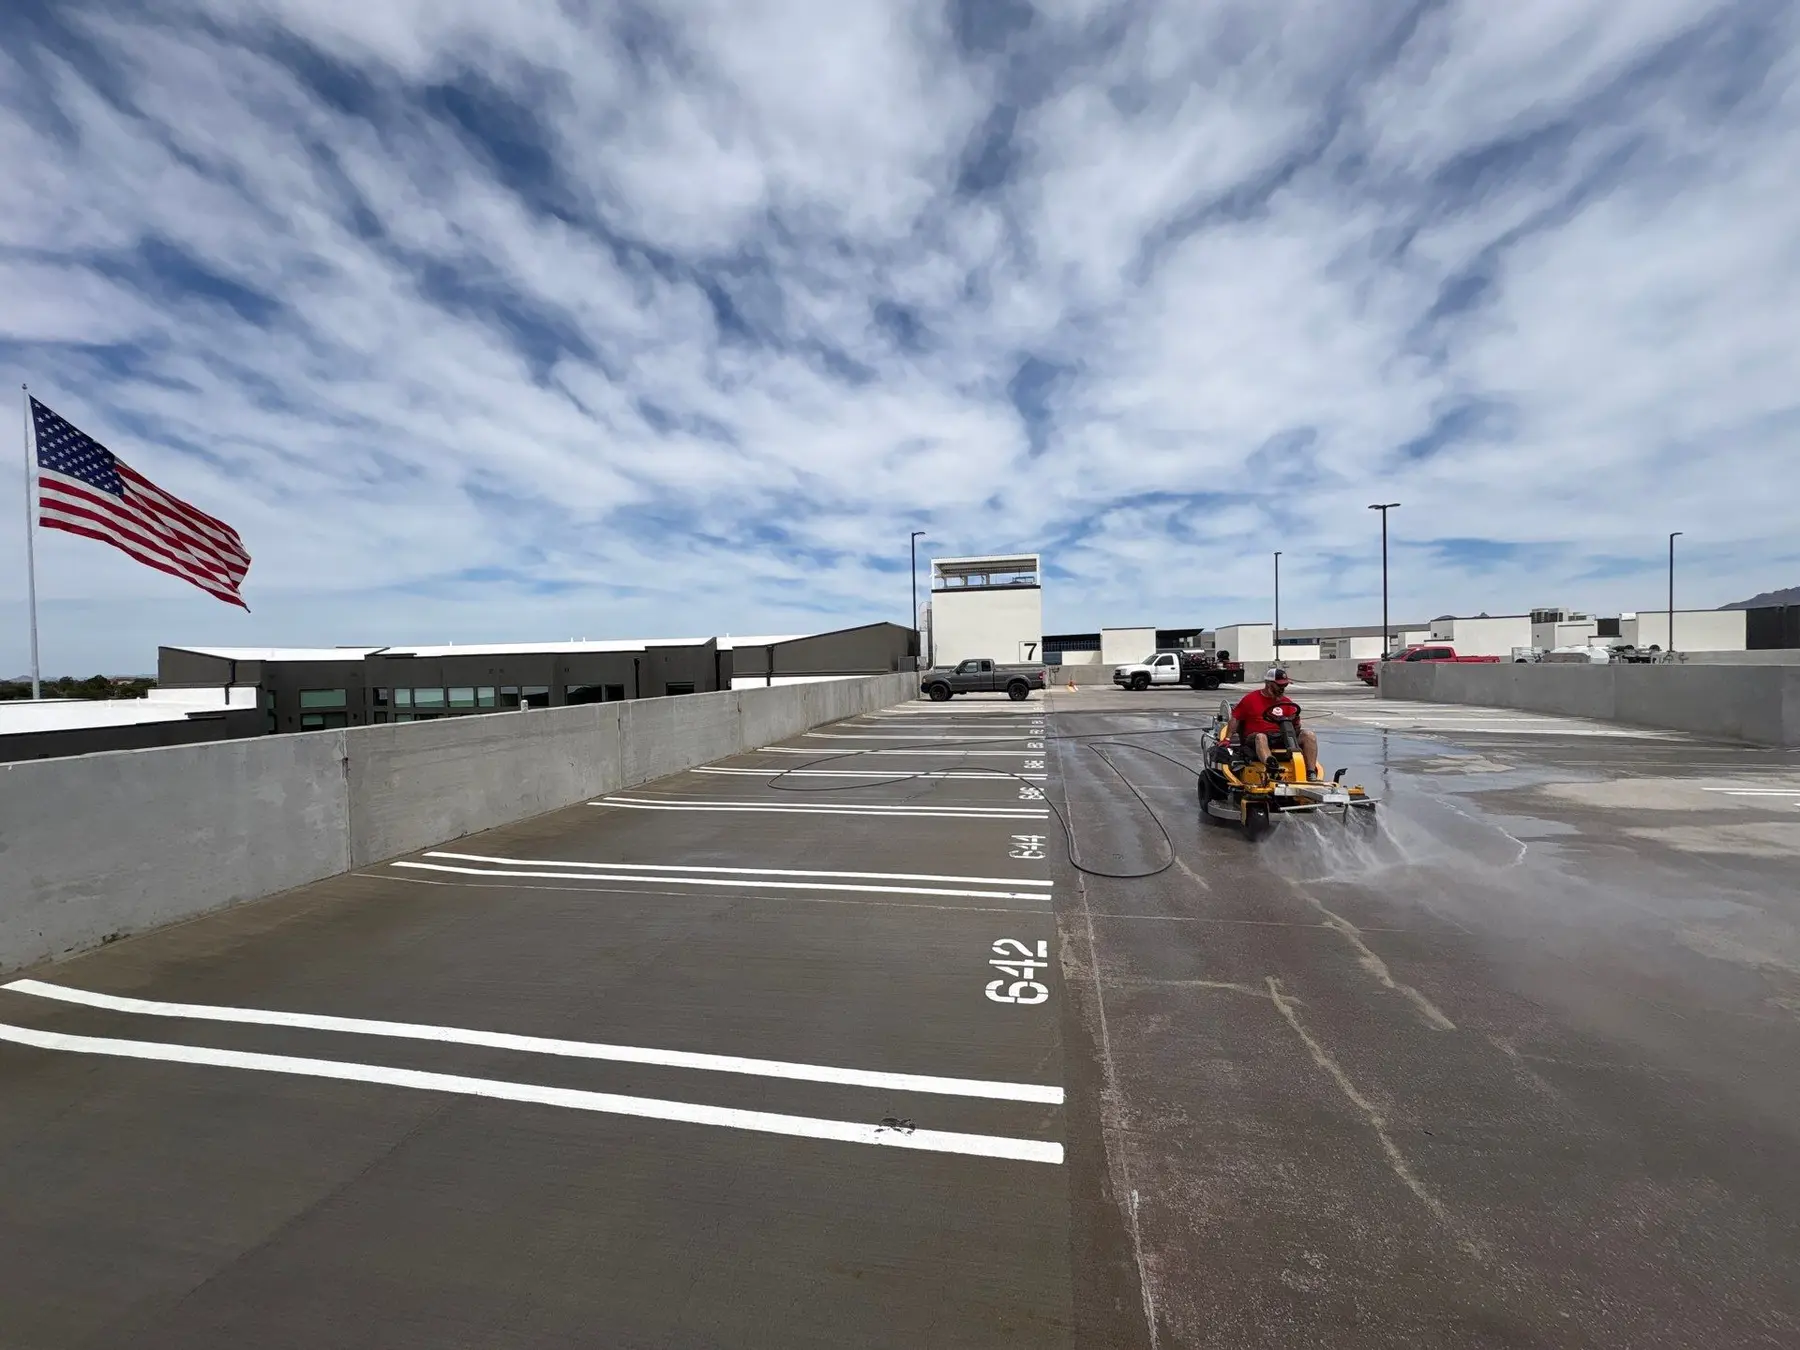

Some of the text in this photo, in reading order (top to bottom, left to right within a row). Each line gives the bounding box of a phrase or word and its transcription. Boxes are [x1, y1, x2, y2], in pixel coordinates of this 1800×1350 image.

[1023, 642, 1038, 661] 7
[1008, 834, 1047, 860] 644
[985, 938, 1049, 1005] 642
